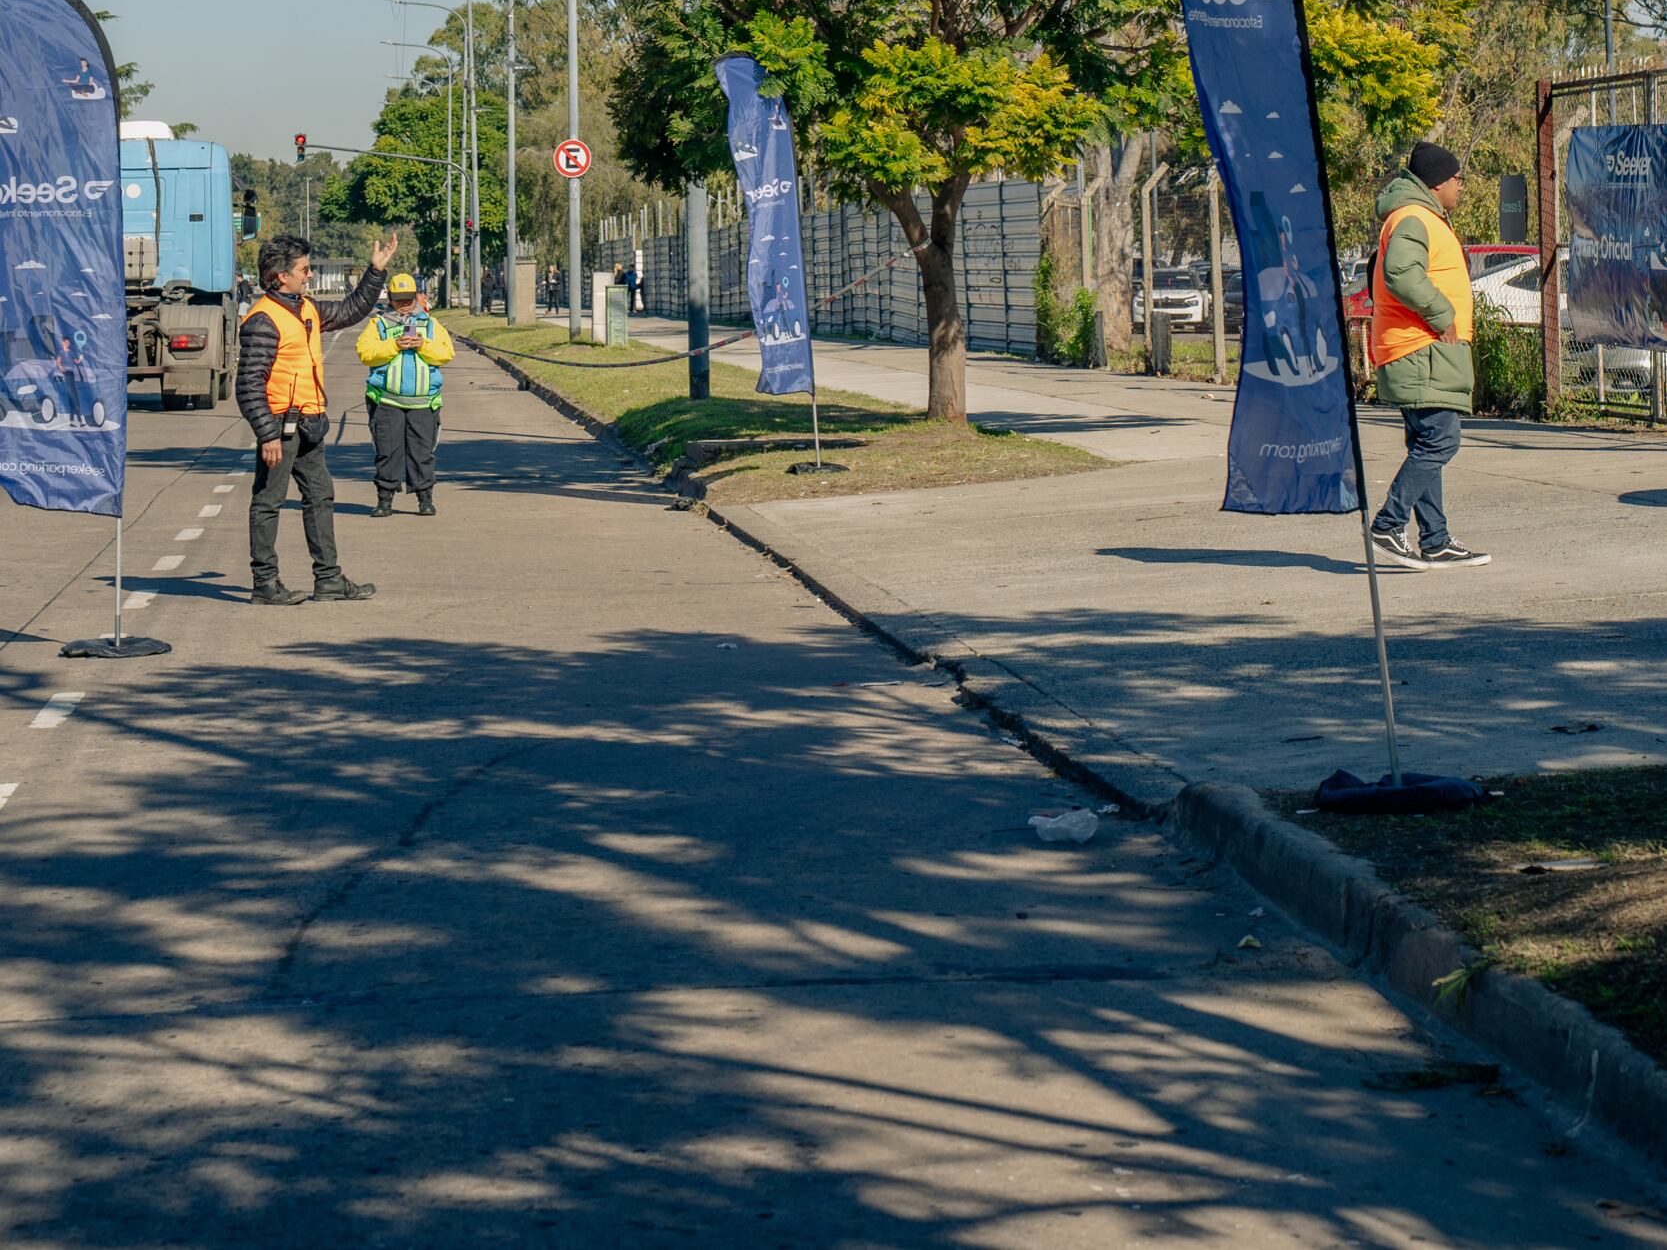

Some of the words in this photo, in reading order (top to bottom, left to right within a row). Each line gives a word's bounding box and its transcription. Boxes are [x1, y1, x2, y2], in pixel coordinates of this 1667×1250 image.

[565, 147, 581, 169] E
[1616, 151, 1652, 176] Seeker
[1600, 232, 1632, 261] Oficial
